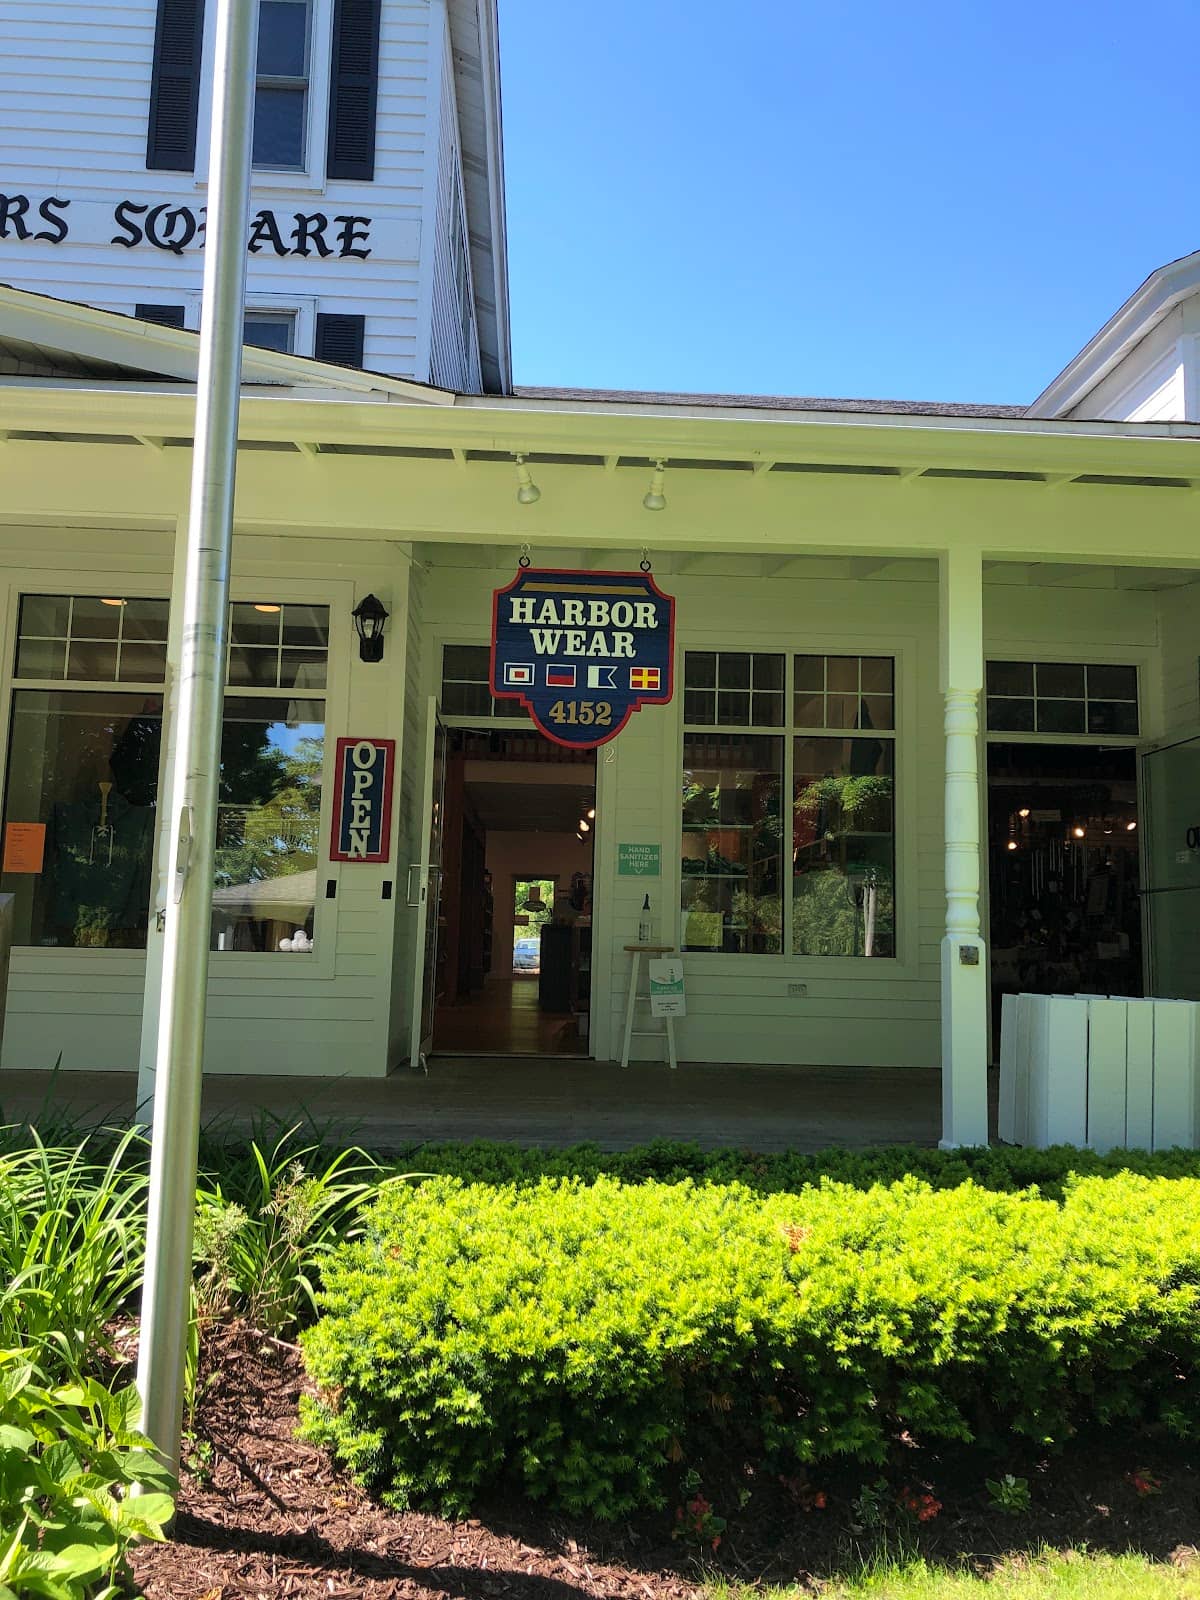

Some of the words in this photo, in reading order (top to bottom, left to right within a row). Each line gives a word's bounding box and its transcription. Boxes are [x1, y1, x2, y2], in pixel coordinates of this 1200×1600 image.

[111, 200, 372, 260] SQARE
[509, 597, 658, 629] HARBOR
[529, 628, 636, 658] WEAR
[548, 700, 612, 726] 4152
[605, 746, 615, 763] 2
[347, 741, 377, 858] OPEN
[620, 853, 659, 861] SANITIZER
